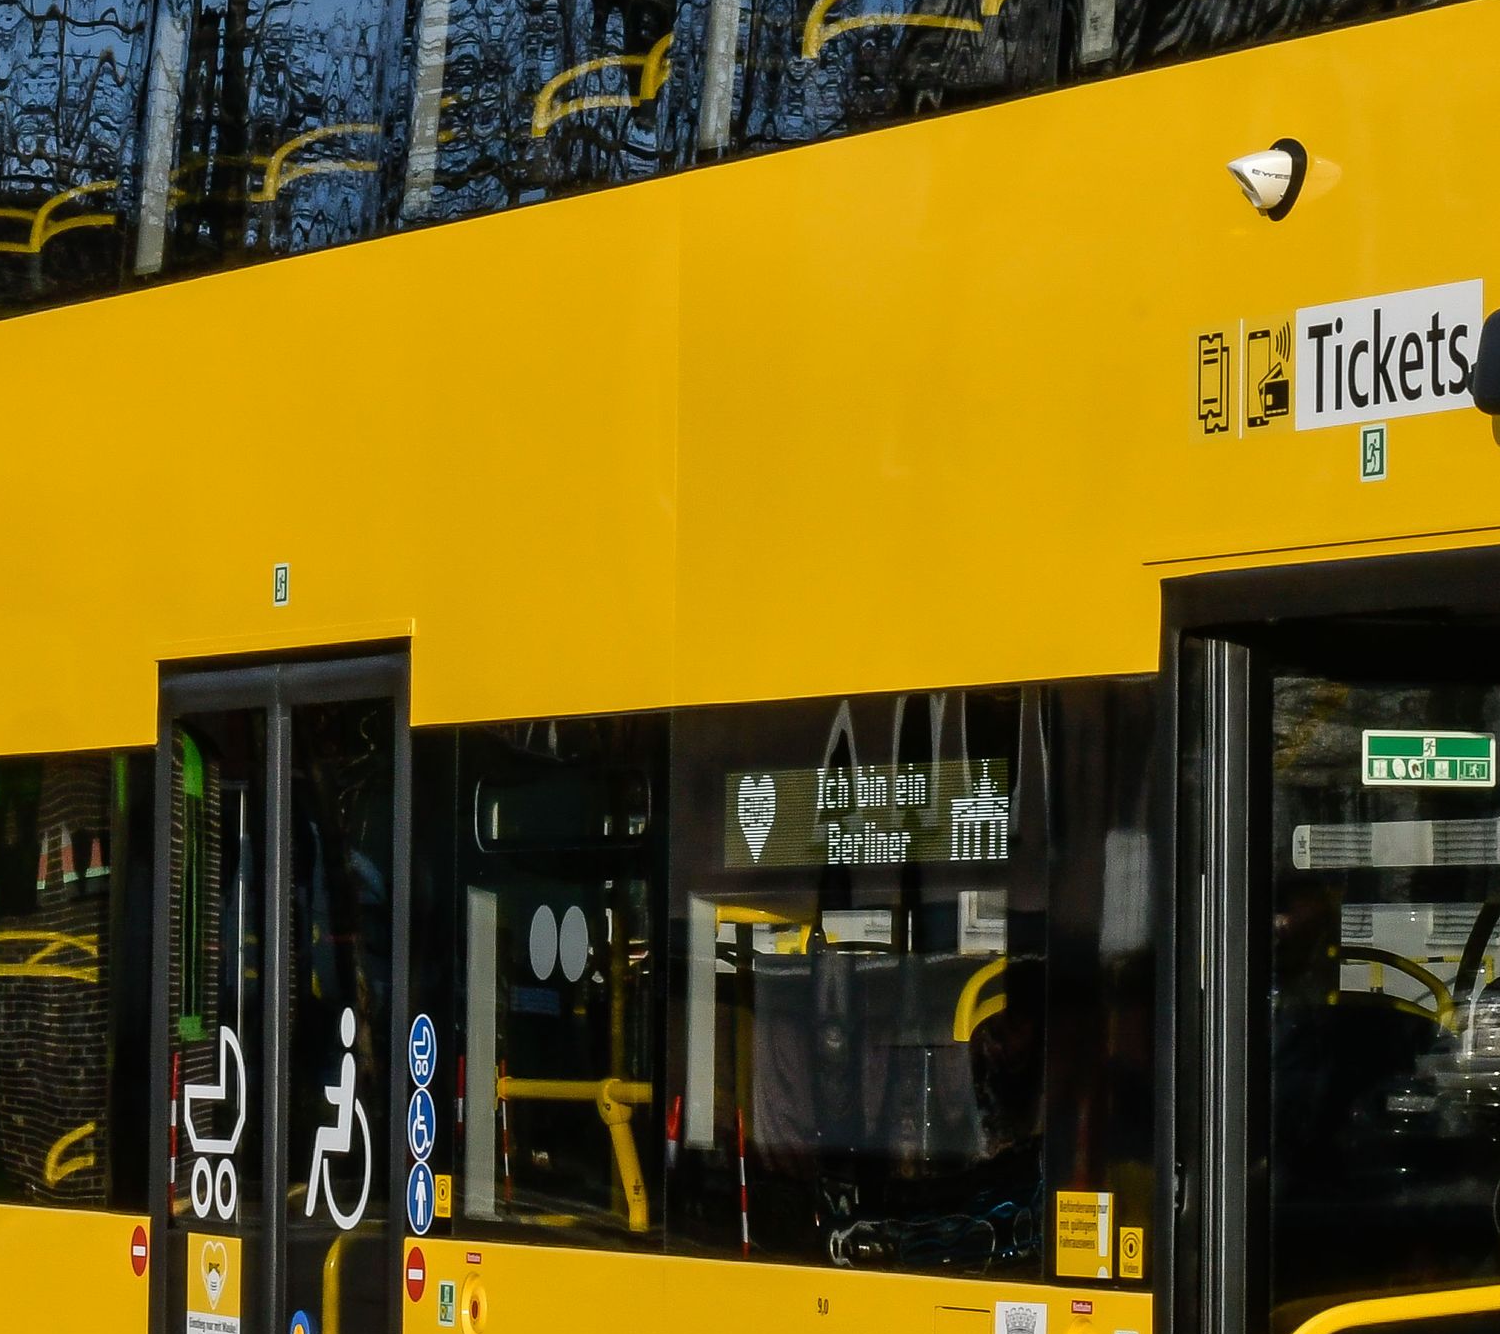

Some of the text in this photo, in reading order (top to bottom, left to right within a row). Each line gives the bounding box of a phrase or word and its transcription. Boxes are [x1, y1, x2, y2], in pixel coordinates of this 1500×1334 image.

[1307, 308, 1469, 413] Tickets
[817, 763, 926, 809] Ich bin ein
[828, 822, 911, 865] Berliner
